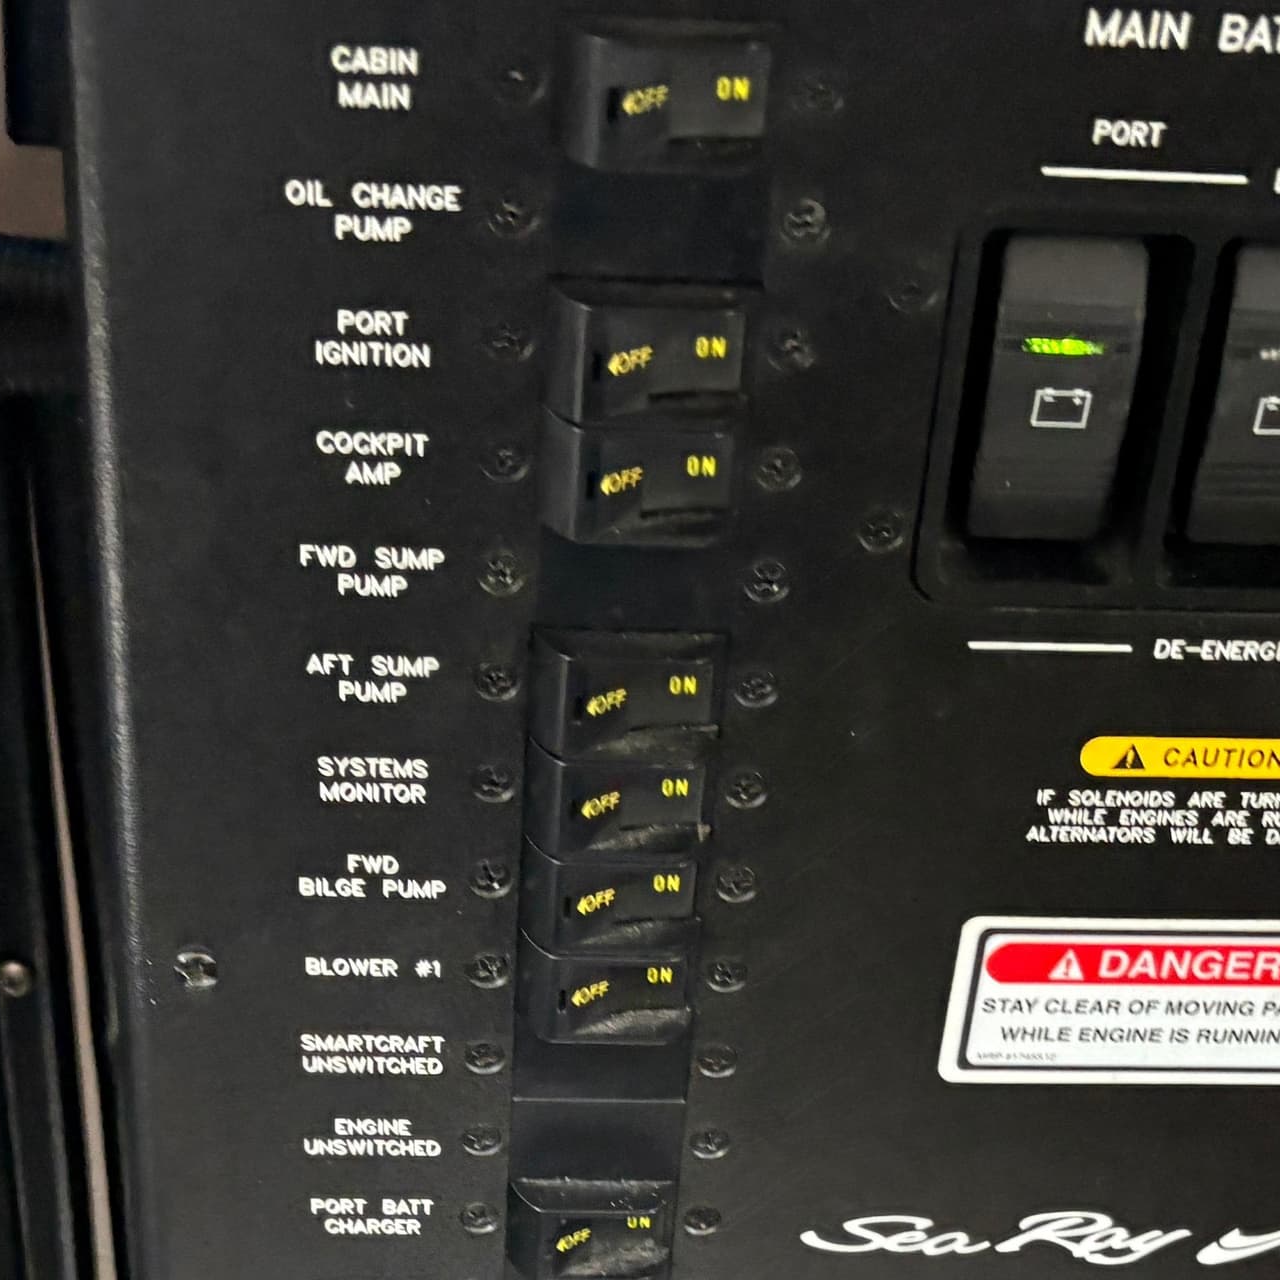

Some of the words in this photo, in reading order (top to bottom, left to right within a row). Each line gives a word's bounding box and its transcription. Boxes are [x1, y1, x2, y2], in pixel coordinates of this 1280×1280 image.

[1085, 8, 1191, 49] MAIN
[331, 45, 418, 75] CABIN
[338, 81, 410, 110] MAIN
[634, 86, 668, 114] OFF
[718, 79, 750, 99] ON
[1092, 119, 1166, 147] PORT
[285, 179, 333, 207] OIL
[351, 182, 461, 211] CHANGE
[335, 214, 412, 241] PUMP
[337, 310, 408, 335] PORT
[315, 340, 430, 367] IGNITION
[620, 346, 653, 374] OFF
[696, 338, 726, 358] ON
[316, 431, 429, 457] COCKPIT
[345, 461, 401, 485] AMP
[611, 469, 642, 493] OFF
[687, 457, 716, 475] ON
[300, 544, 356, 568] FWD
[375, 547, 445, 570] SUMP
[338, 573, 408, 597] PUMP
[306, 654, 354, 675] AFT
[371, 655, 440, 677] SUMP
[339, 680, 407, 703] PUMP
[597, 689, 627, 714] OFF
[670, 677, 697, 694] ON
[317, 756, 428, 779] SYSTEMS
[320, 782, 426, 804] MONITOR
[590, 792, 619, 818] OFF
[662, 780, 689, 797] ON
[1037, 789, 1056, 805] IF
[1065, 790, 1175, 809] SOLENOIDS
[1187, 791, 1226, 808] ARE
[1048, 808, 1107, 826] WHILE
[1116, 809, 1199, 827] ENGINES
[1211, 810, 1250, 827] ARE
[1026, 825, 1156, 843] ALTERNATORS
[1170, 827, 1213, 844] WILL
[1227, 829, 1254, 845] BE
[347, 854, 399, 874] FWD
[299, 877, 366, 897] BILGE
[383, 879, 446, 899] PUMP
[586, 890, 614, 912] OFF
[653, 876, 680, 892] ON
[305, 957, 398, 977] BLOWER
[415, 960, 441, 978] #1
[581, 982, 608, 1004] OFF
[648, 968, 672, 984] ON
[982, 998, 1037, 1014] STAY
[1045, 999, 1122, 1015] CLEAR
[1133, 1000, 1161, 1015] OF
[1164, 1001, 1255, 1017] MOVING
[300, 1034, 445, 1053] SMARTCRAFT
[1001, 1027, 1071, 1042] WHILE
[1079, 1027, 1164, 1043] ENGINE
[1169, 1029, 1190, 1043] IS
[302, 1056, 443, 1075] UNSWITCHED
[334, 1118, 412, 1136] ENGINE
[304, 1138, 441, 1156] UNSWITCHED
[310, 1198, 368, 1215] PORT
[382, 1199, 434, 1215] BATT
[324, 1218, 421, 1235] CHARGER
[800, 1212, 992, 1258] Sea
[994, 1210, 1191, 1264] Ray
[564, 1229, 590, 1250] OFF
